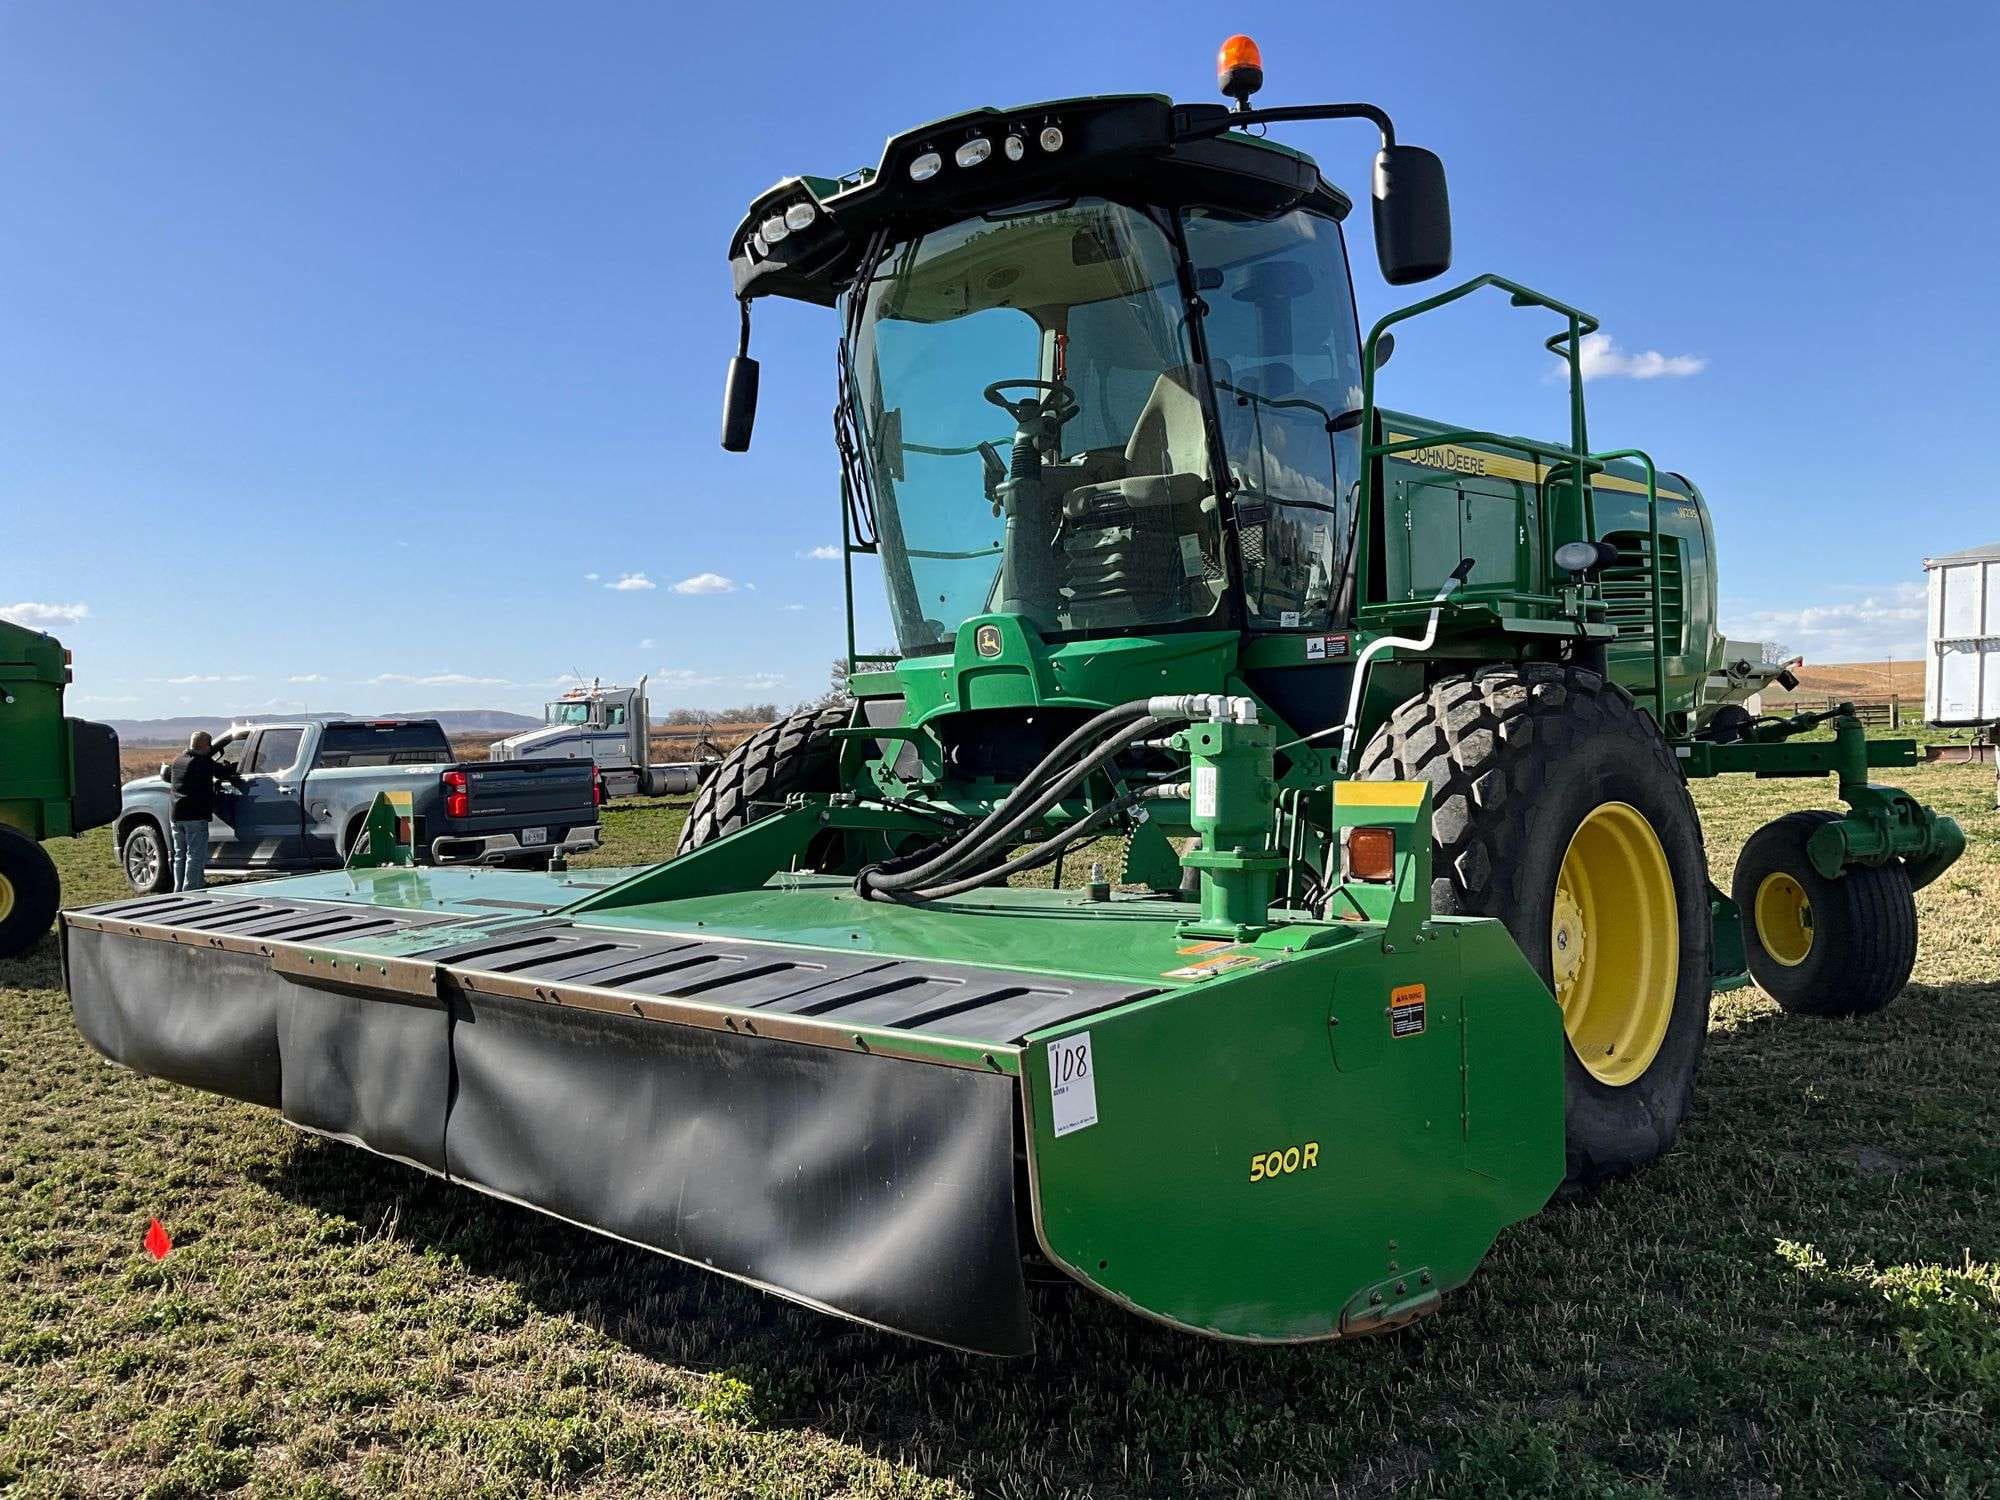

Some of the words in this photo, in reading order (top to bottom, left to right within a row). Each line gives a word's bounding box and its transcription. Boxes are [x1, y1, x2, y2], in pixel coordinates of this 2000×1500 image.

[1410, 447, 1445, 467] JOHN
[1446, 448, 1486, 474] DEERE
[1054, 1045, 1087, 1088] 108
[1249, 1141, 1320, 1183] 500R
